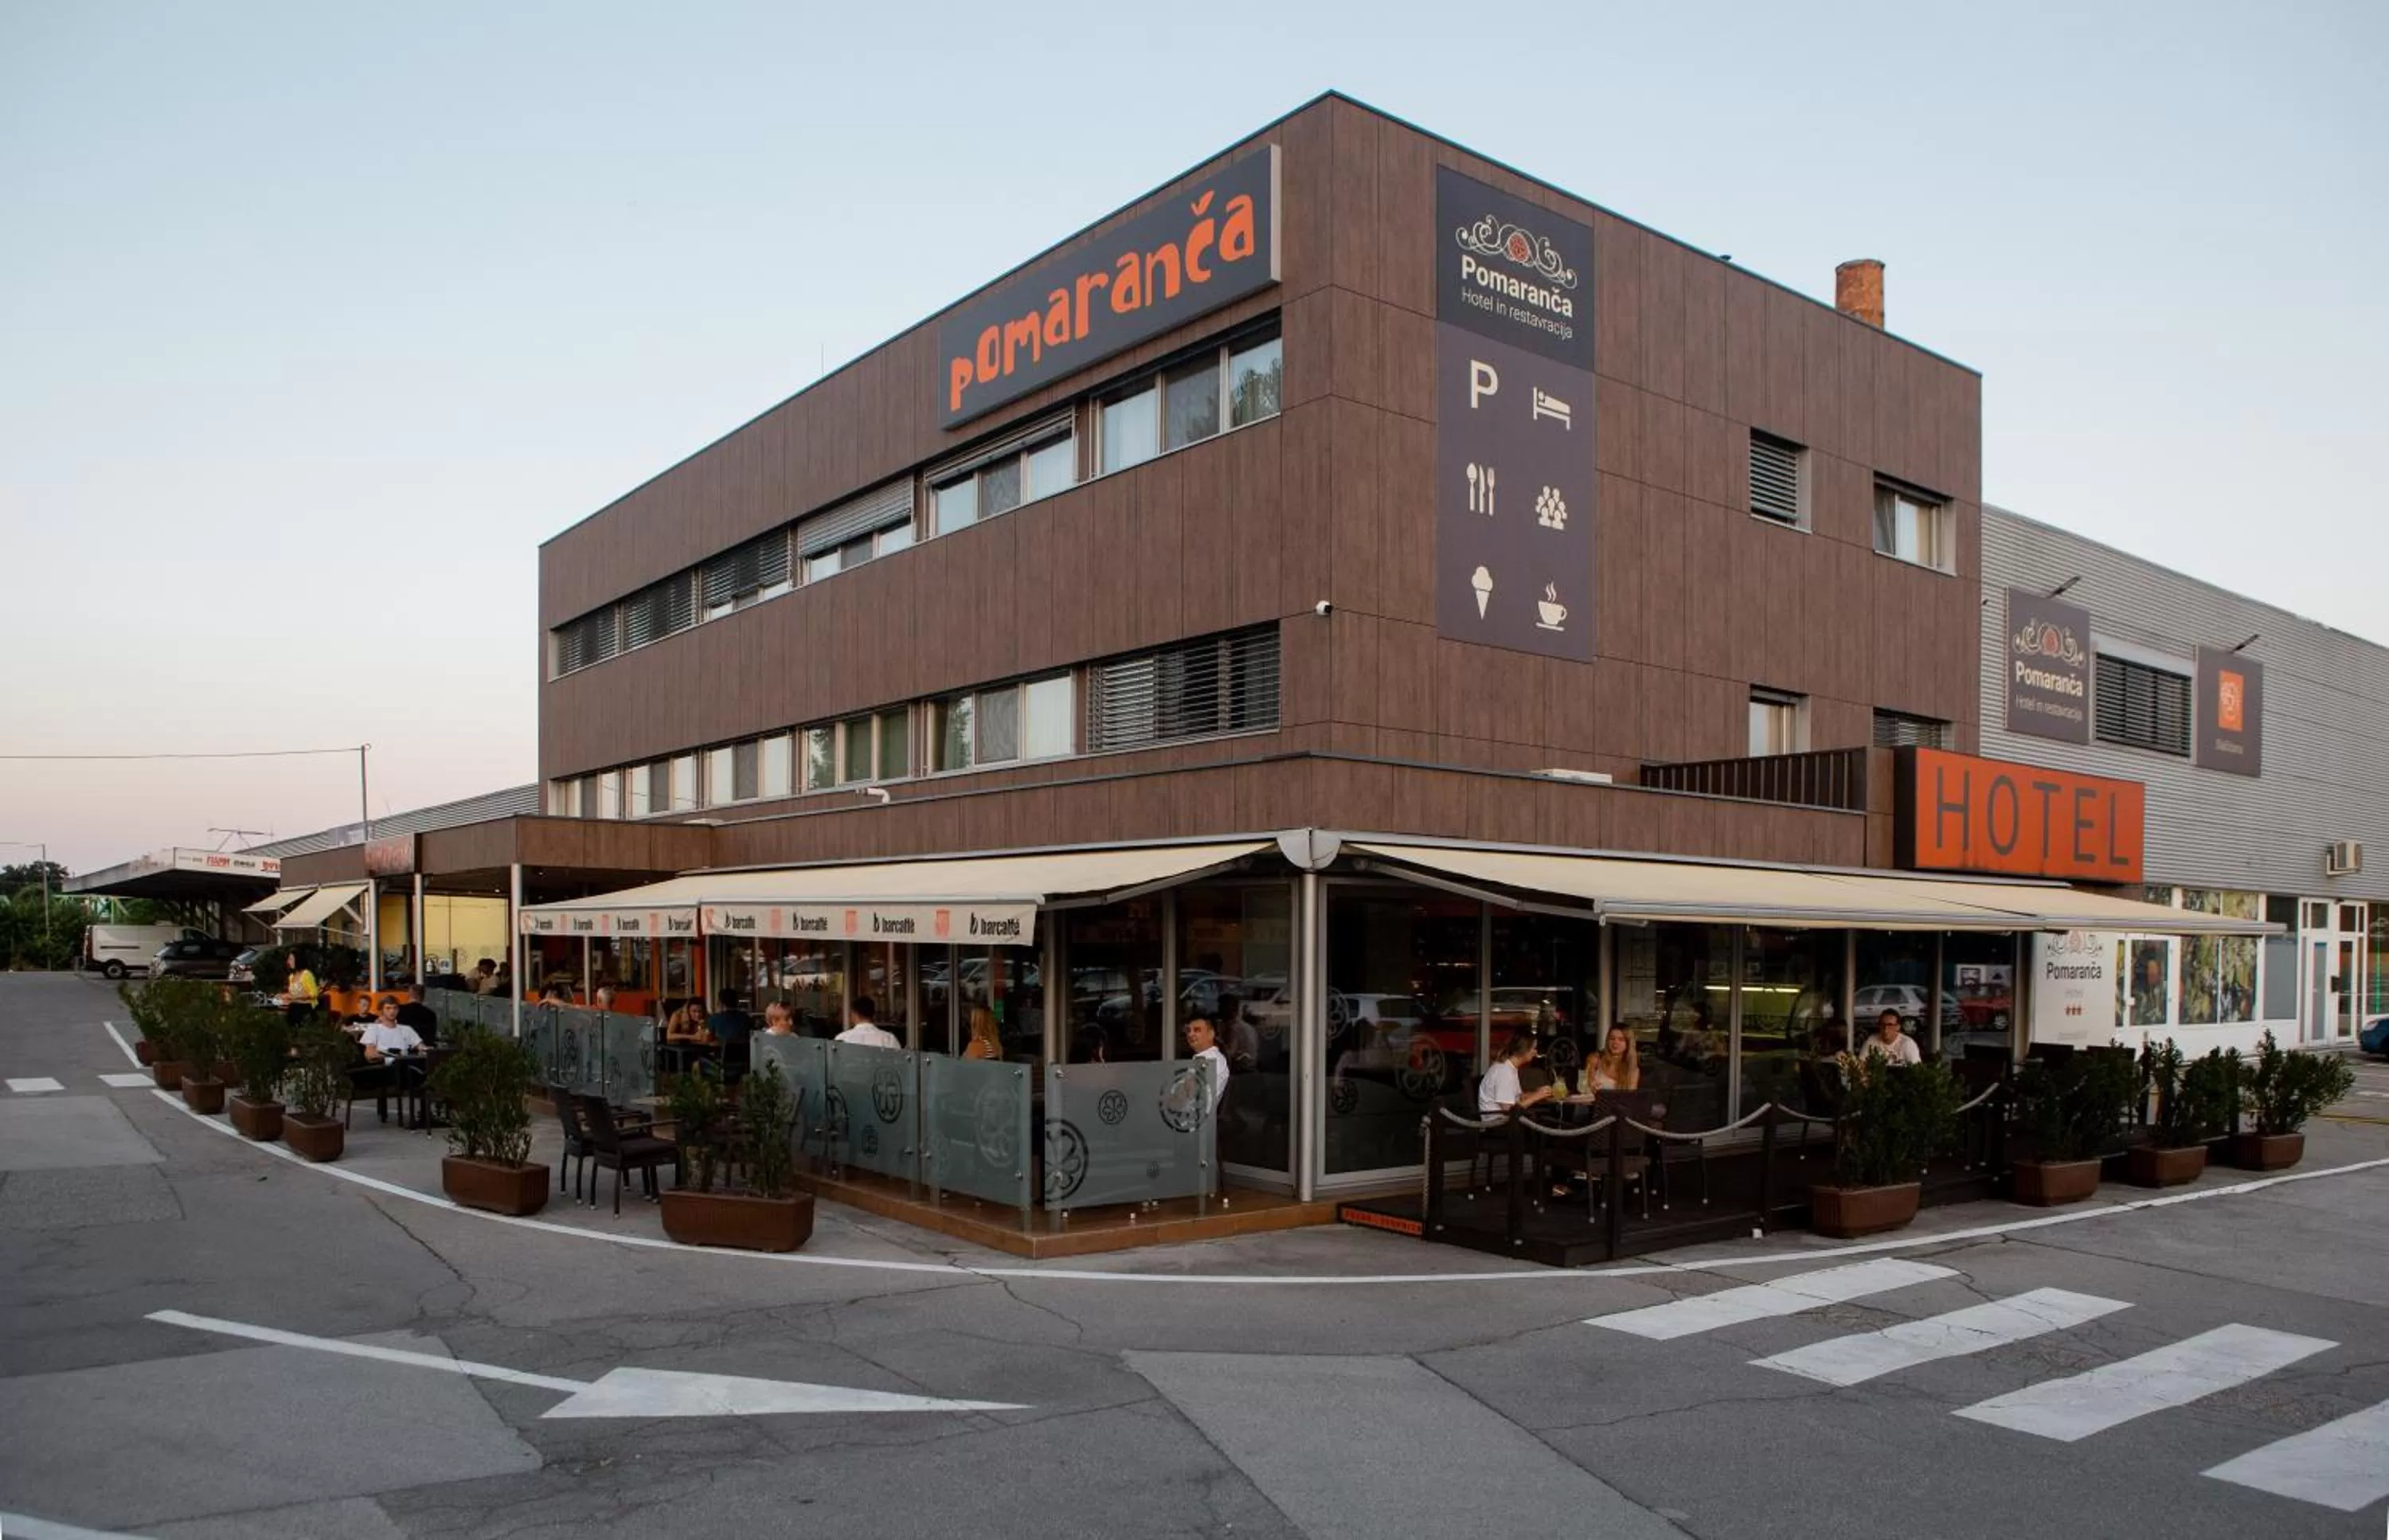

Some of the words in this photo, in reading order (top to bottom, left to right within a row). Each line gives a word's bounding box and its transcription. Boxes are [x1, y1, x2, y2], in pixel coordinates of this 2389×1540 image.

[951, 190, 1255, 411] pomaranča
[1461, 254, 1574, 318] Pomaranča
[1461, 287, 1493, 311] Hotel
[1496, 299, 1507, 316] in
[1509, 306, 1574, 339] restavracija
[2016, 660, 2082, 698] Pomaranča
[1936, 766, 2129, 866] HOTEL
[2046, 960, 2102, 980] Pomaranča
